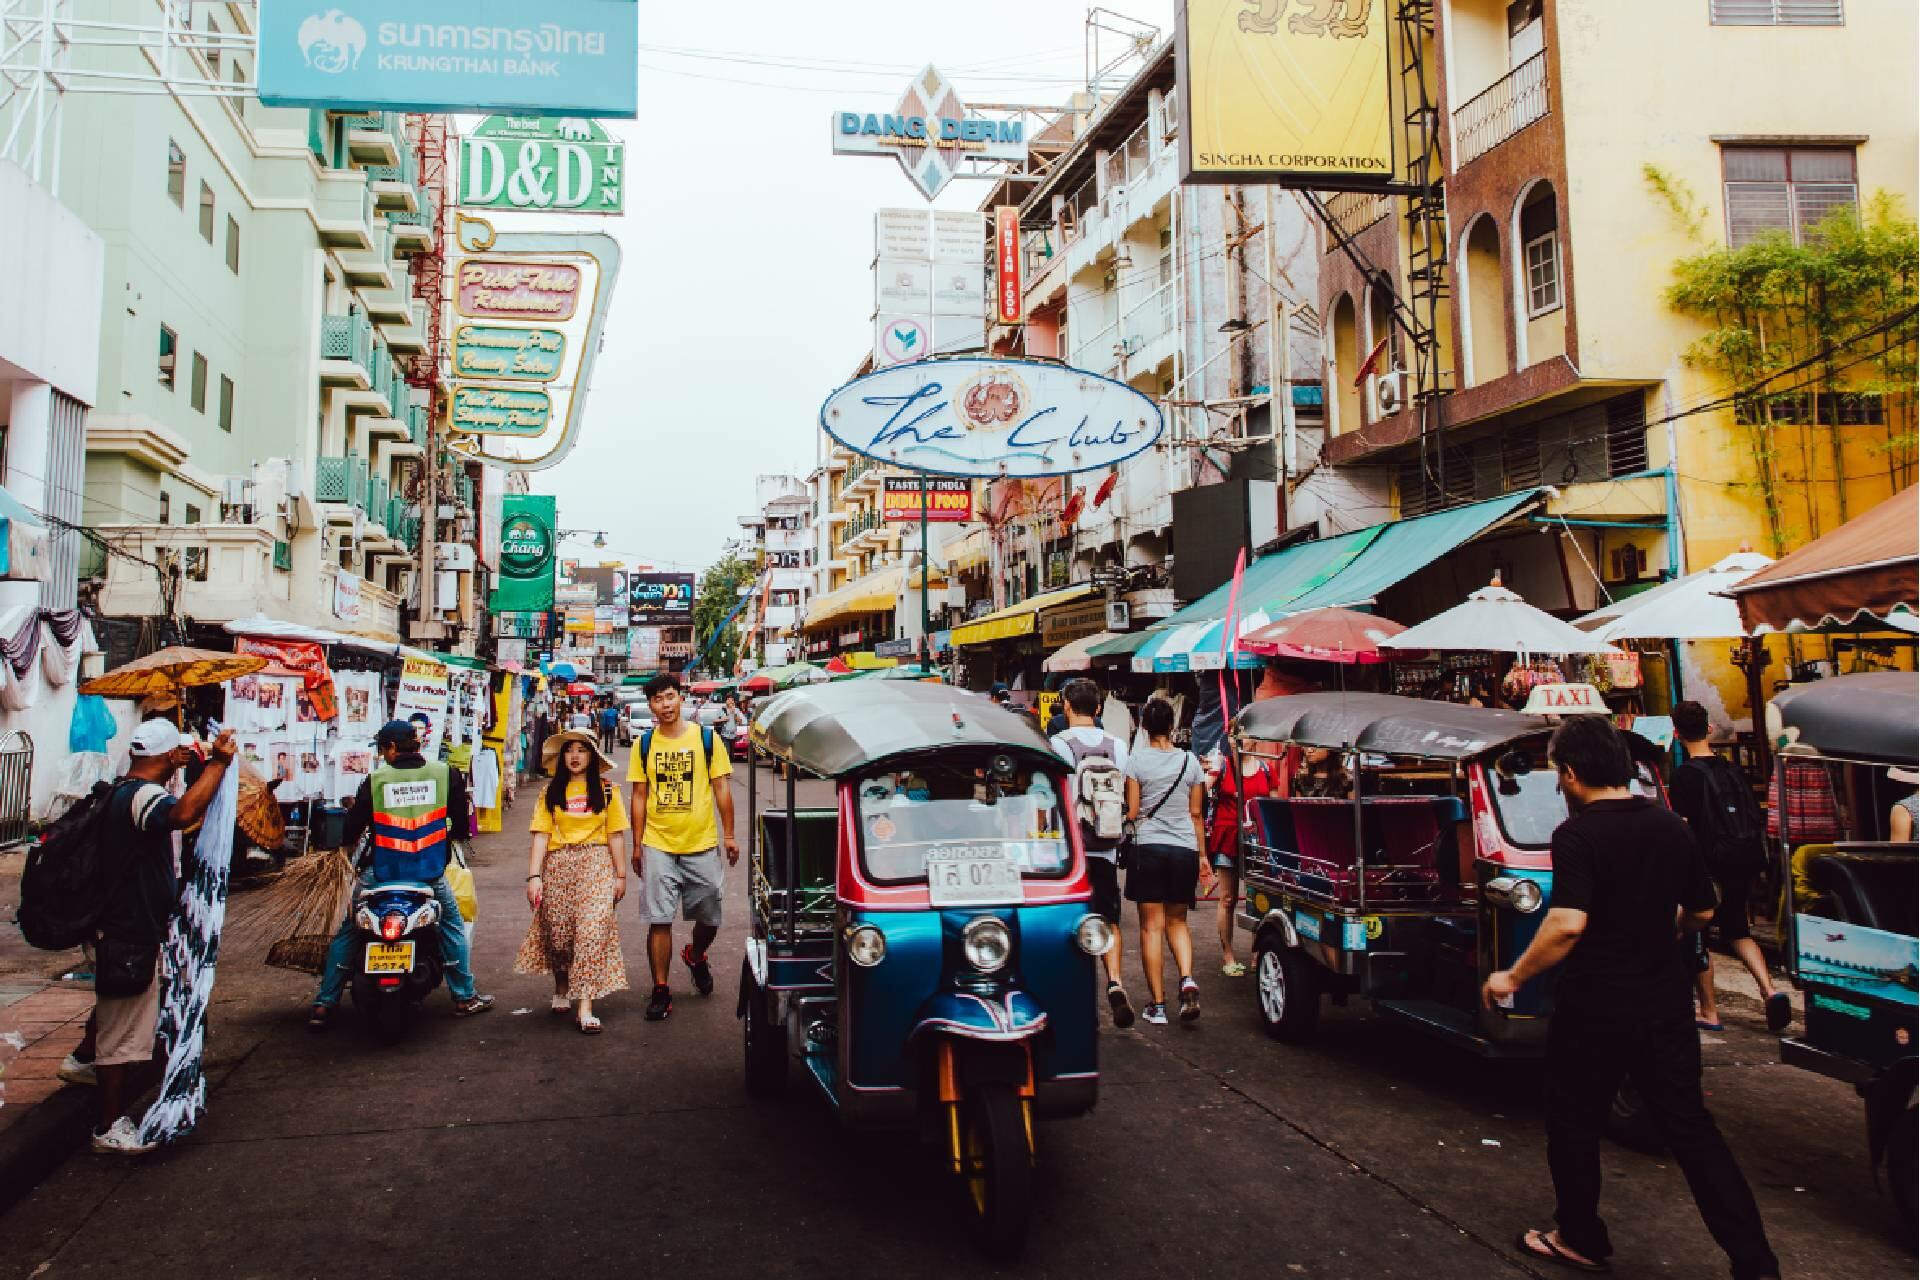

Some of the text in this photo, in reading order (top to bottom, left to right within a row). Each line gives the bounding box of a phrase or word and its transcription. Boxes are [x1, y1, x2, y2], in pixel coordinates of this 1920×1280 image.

[378, 21, 605, 58] ธนาคารกรุงไทย
[378, 54, 560, 77] KRUNGTHAI BANK
[841, 112, 1023, 143] DANG DERM
[463, 140, 593, 208] D&D
[1199, 153, 1387, 169] SINGHA CORPORATION
[600, 146, 620, 205] INN
[1003, 220, 1016, 316] INDIAN FOOD
[862, 382, 1140, 448] The Club
[887, 480, 920, 491] TASTE
[937, 481, 966, 491] INDIA
[934, 494, 969, 509] FOOD
[500, 540, 545, 557] Chang
[1542, 688, 1592, 706] TAXI
